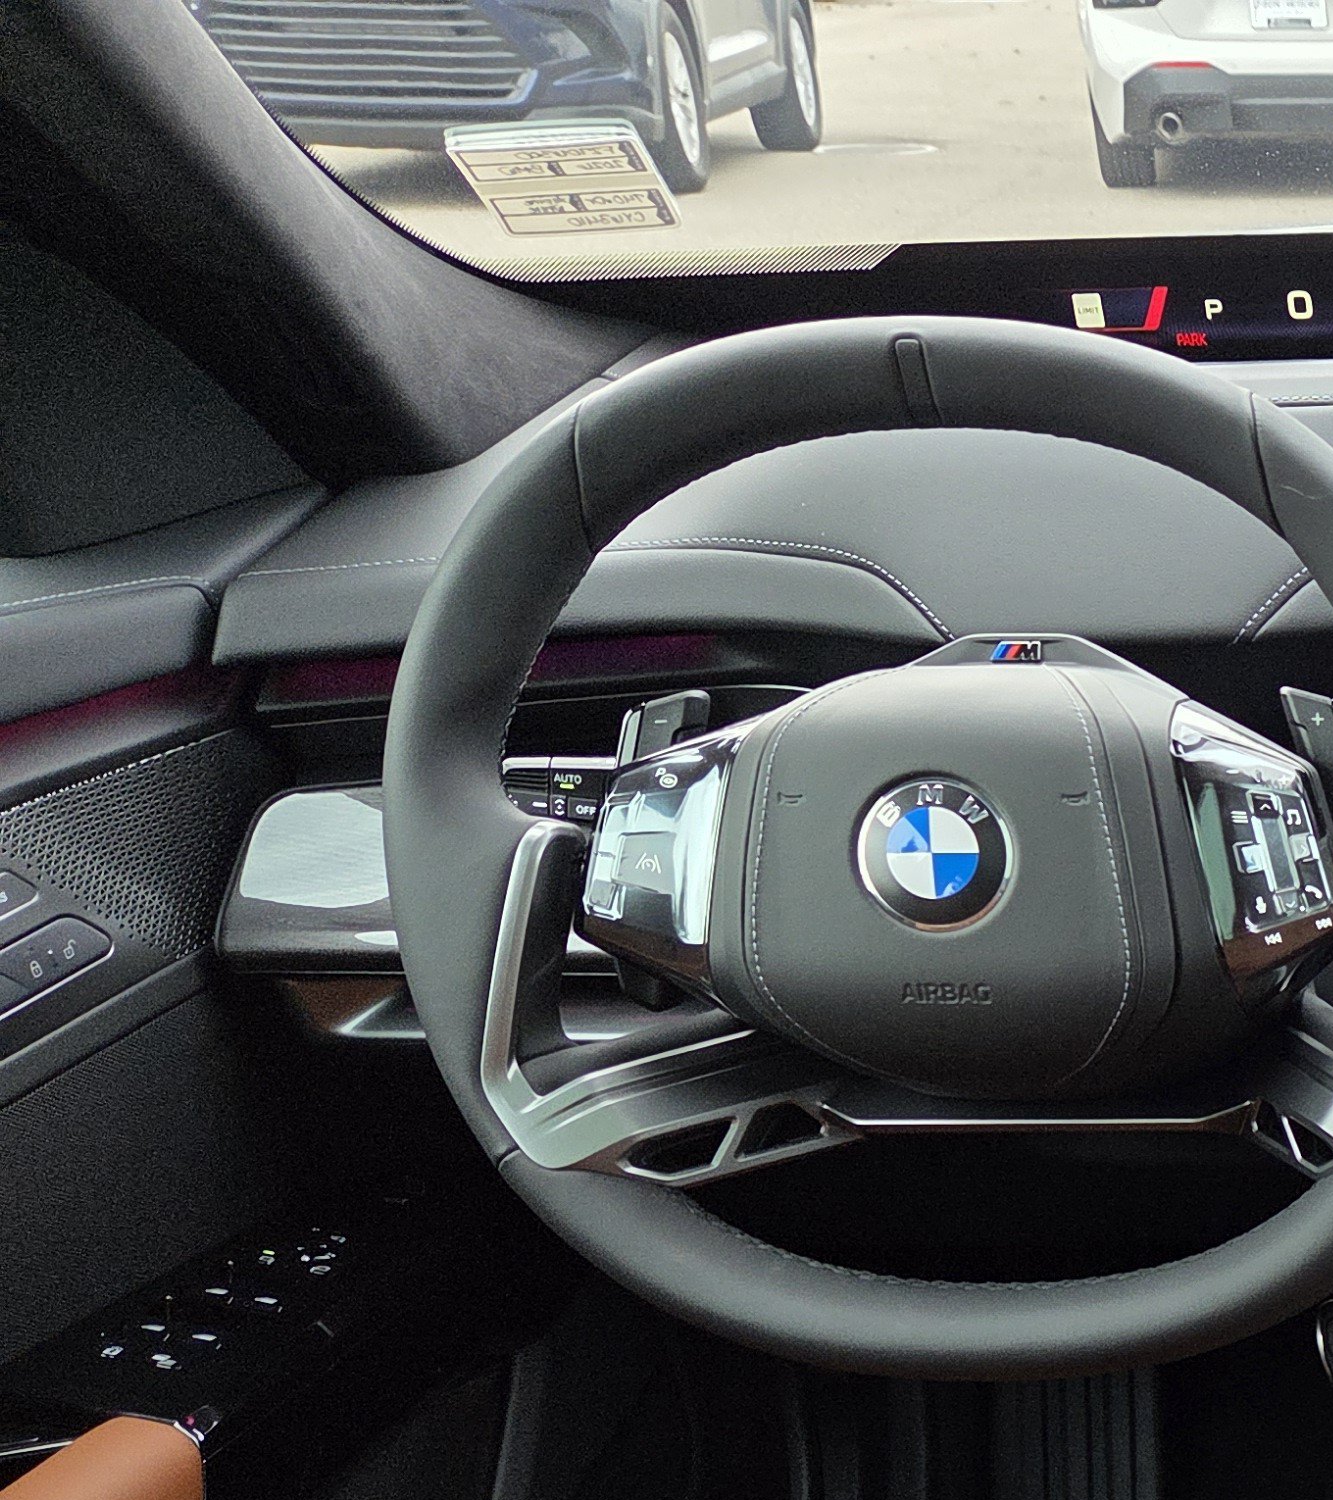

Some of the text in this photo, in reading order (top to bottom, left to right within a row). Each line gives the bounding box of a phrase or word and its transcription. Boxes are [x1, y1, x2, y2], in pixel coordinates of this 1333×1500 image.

[1077, 306, 1099, 315] LIMIT
[1204, 298, 1223, 321] P
[1175, 332, 1208, 346] PARK
[554, 773, 582, 784] AUTO
[575, 805, 596, 816] OFF
[877, 784, 990, 825] BMW
[901, 982, 992, 1007] AIRBAG
